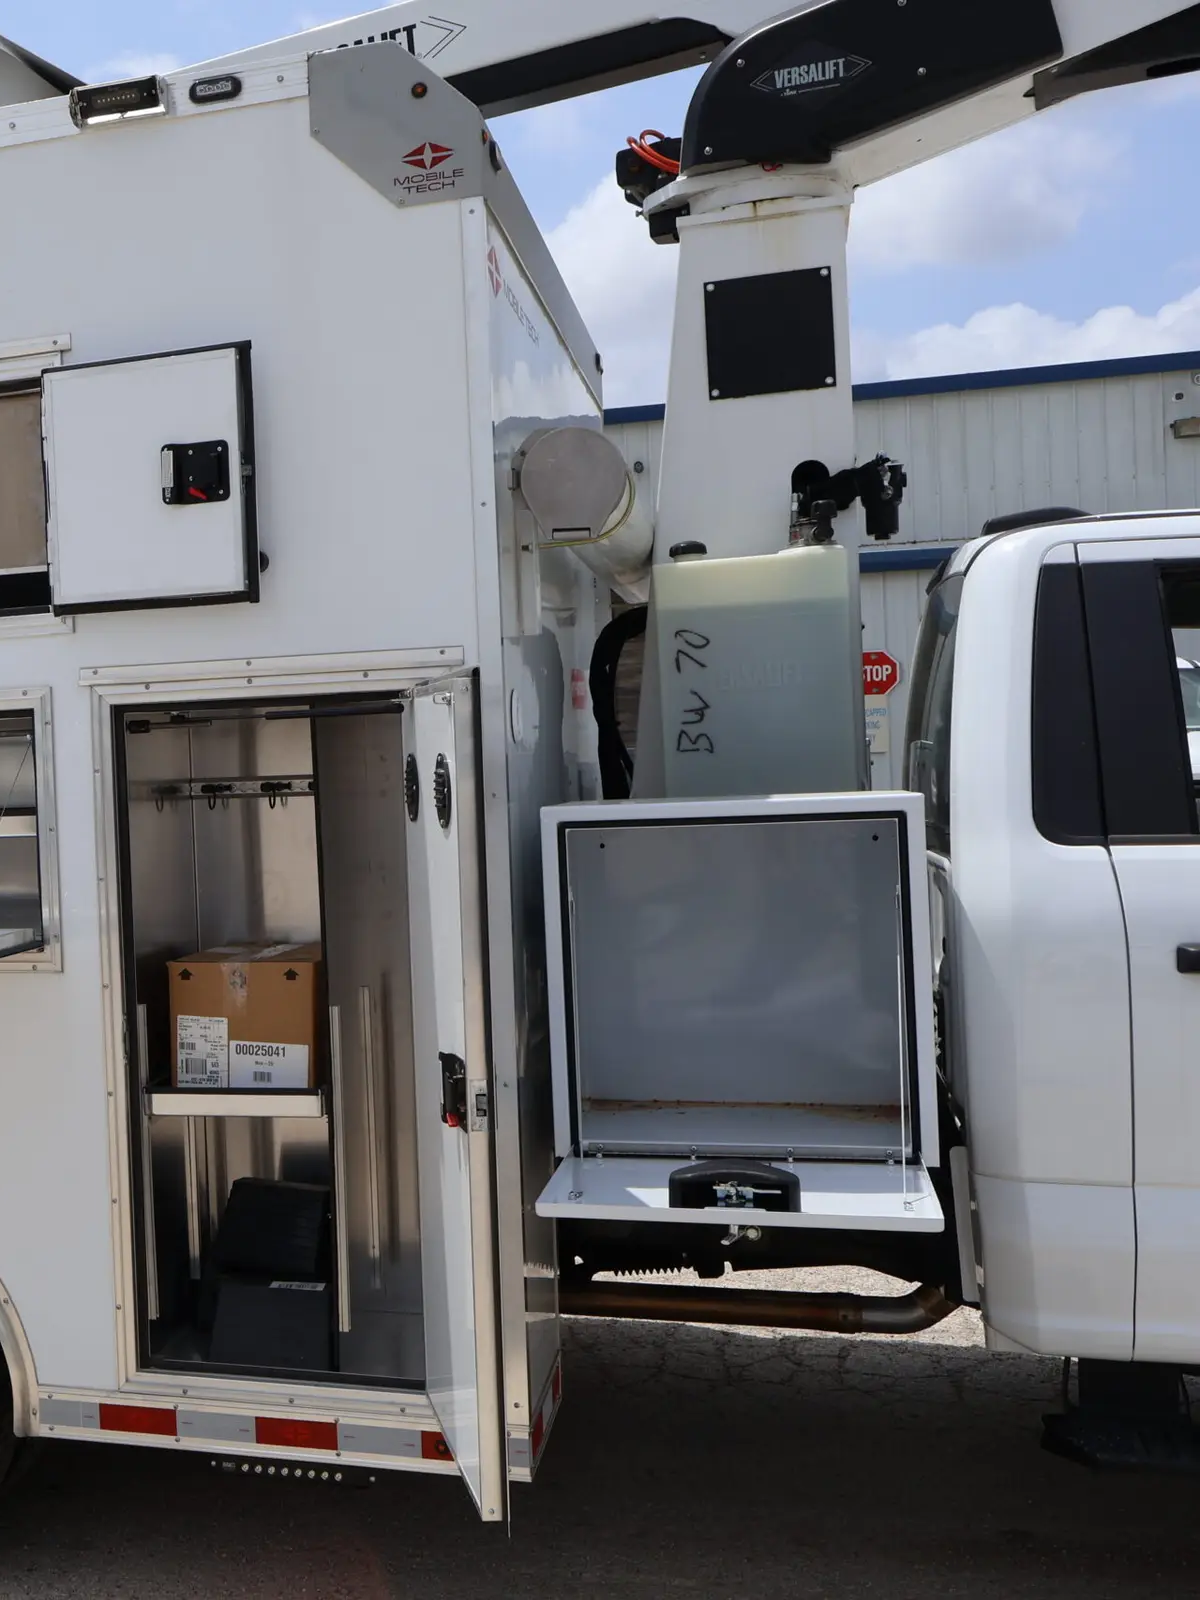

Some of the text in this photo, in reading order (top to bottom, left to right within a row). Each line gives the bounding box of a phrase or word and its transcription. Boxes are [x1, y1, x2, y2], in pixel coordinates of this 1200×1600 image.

[774, 58, 846, 89] VERSALIFT
[393, 168, 465, 187] MOBILE
[402, 180, 456, 195] TECH
[675, 629, 711, 674] 70
[235, 1044, 286, 1058] 00025041
